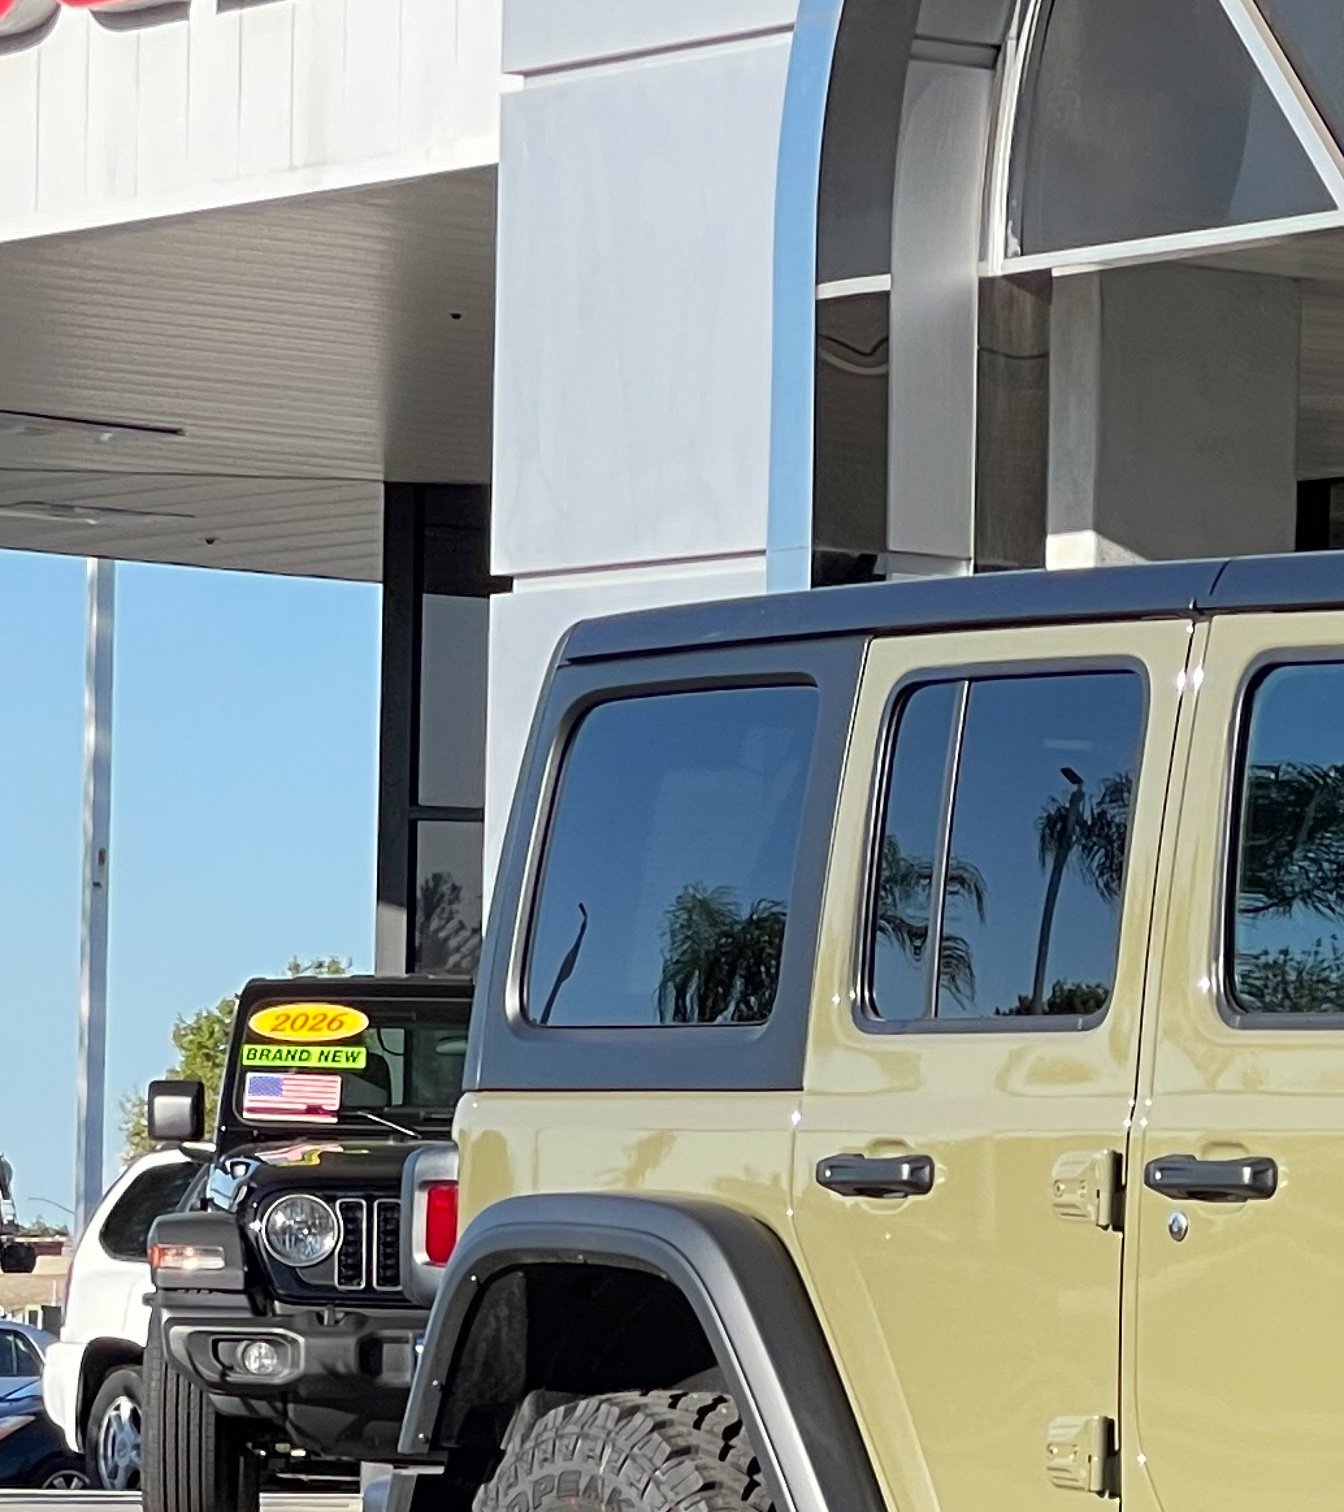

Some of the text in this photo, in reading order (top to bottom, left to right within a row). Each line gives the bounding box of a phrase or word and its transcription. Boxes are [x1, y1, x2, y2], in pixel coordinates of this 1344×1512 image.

[270, 1012, 349, 1033] 2026
[246, 1047, 362, 1064] BRAND NEW
